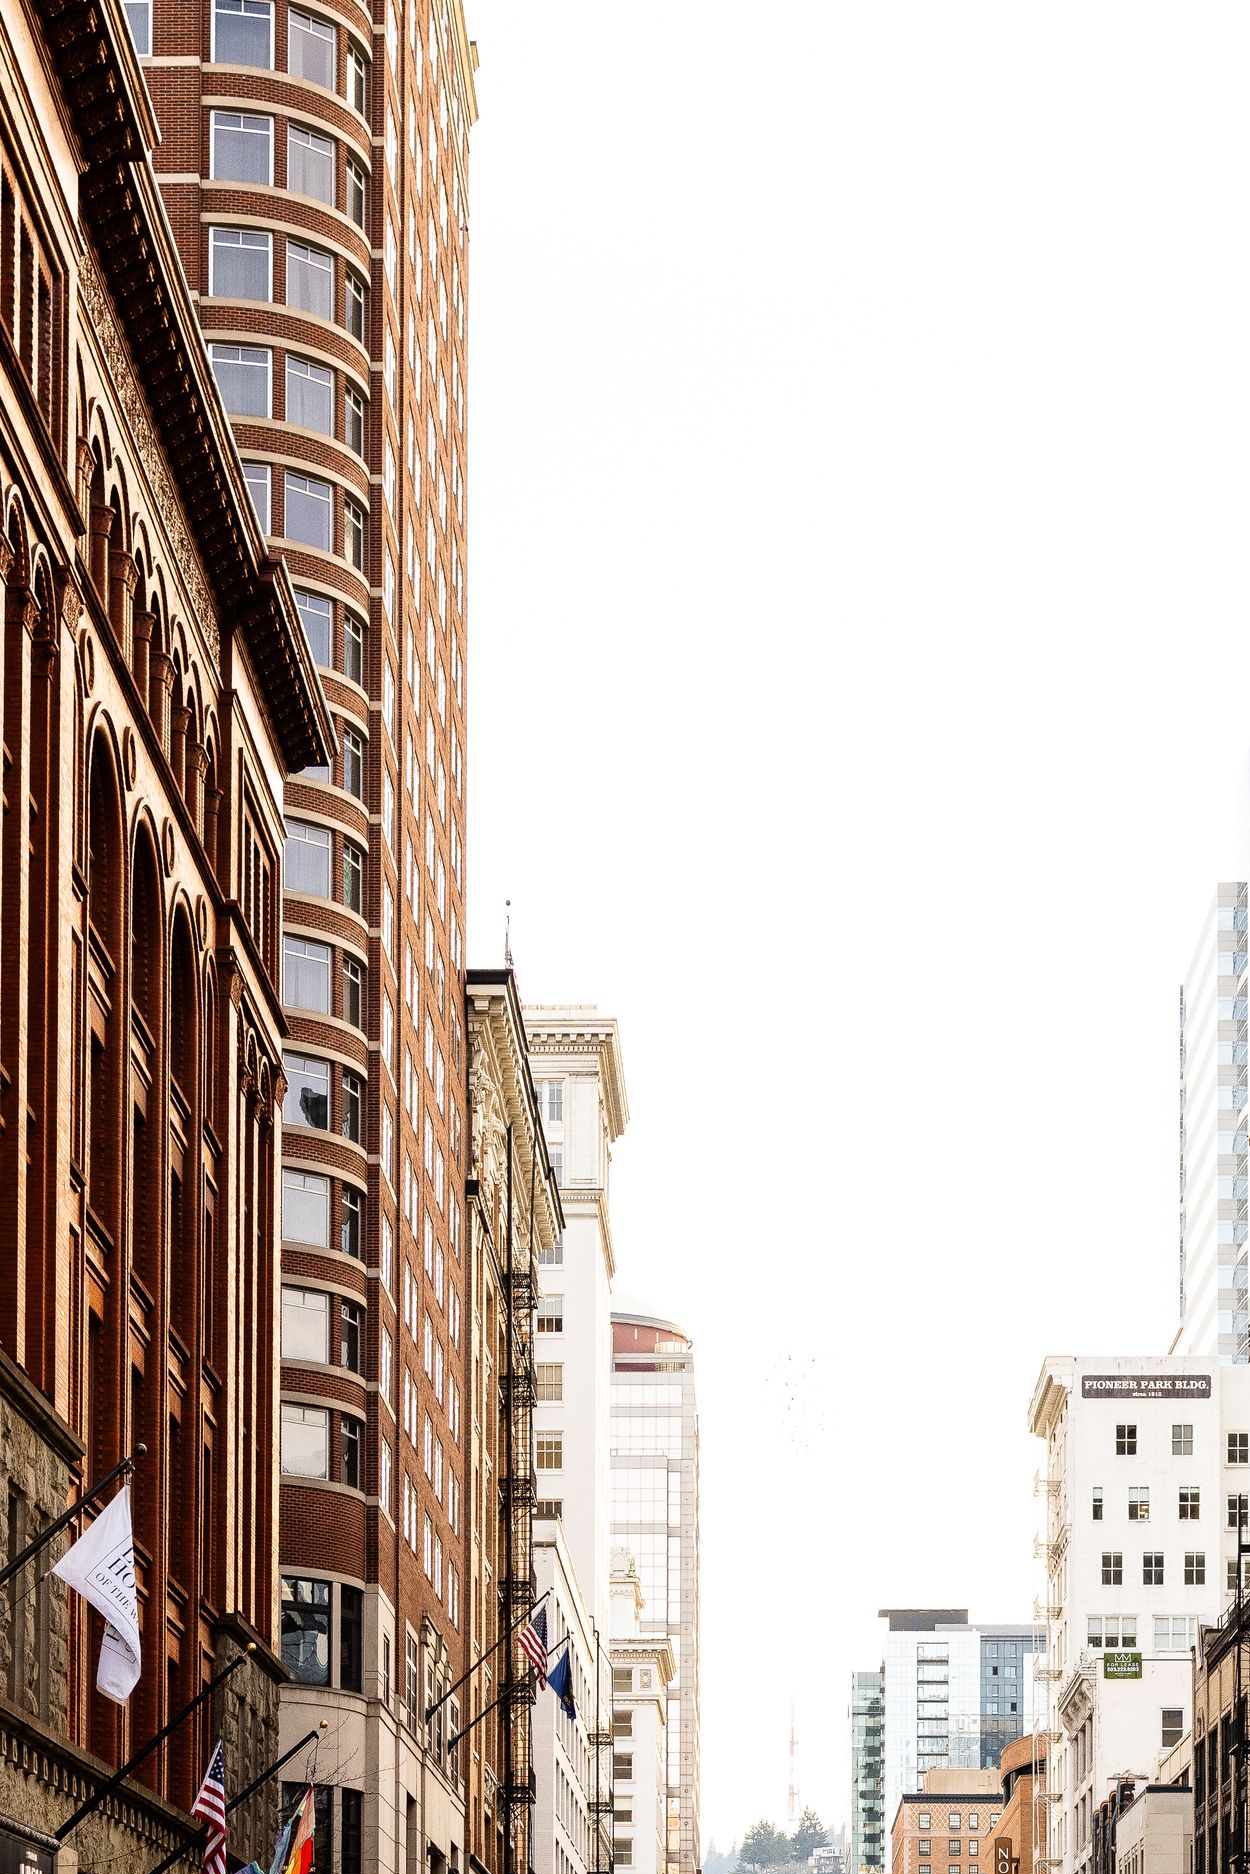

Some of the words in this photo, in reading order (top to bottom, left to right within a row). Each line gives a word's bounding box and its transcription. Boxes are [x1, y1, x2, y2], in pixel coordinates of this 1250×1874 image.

[1084, 1380, 1138, 1390] PIONEER
[1140, 1380, 1173, 1390] PARK
[1174, 1380, 1210, 1390] BLDG.
